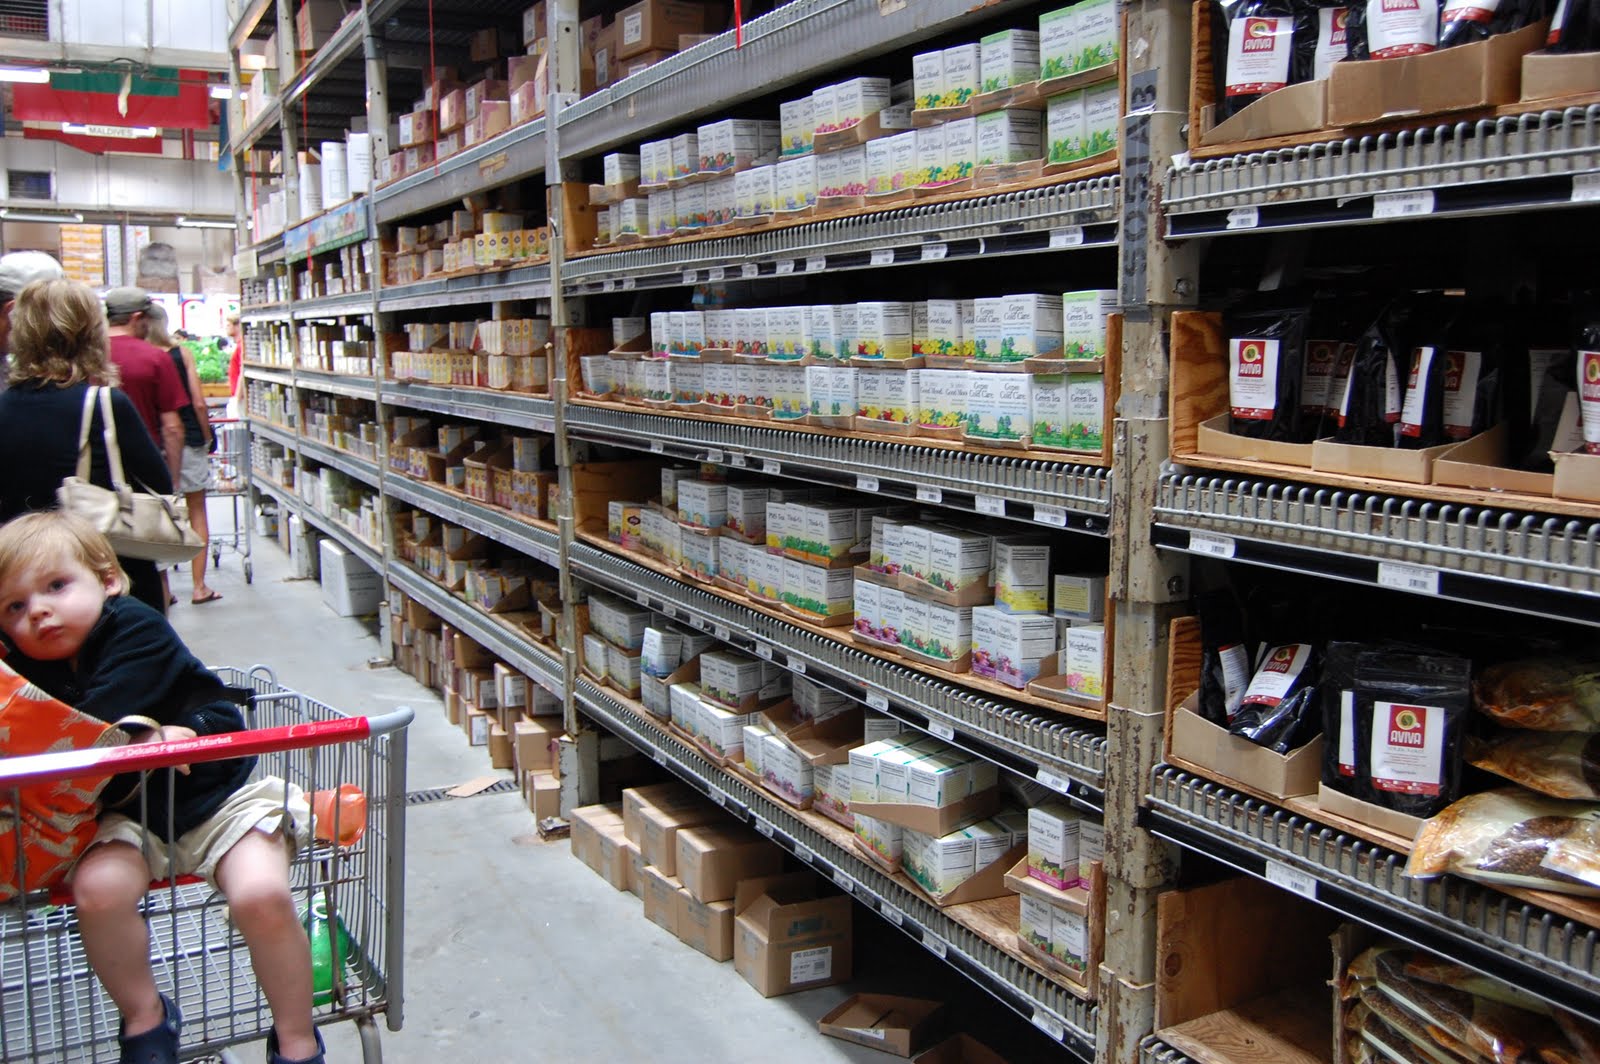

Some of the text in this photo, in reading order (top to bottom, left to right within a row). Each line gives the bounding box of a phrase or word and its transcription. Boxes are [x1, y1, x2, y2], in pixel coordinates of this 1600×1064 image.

[1244, 38, 1273, 50] AVIVA
[89, 126, 133, 137] MALDIVES
[1240, 363, 1262, 375] AVIVA
[1391, 730, 1422, 745] AVIVA
[160, 742, 199, 754] Farmers
[200, 735, 233, 747] Market
